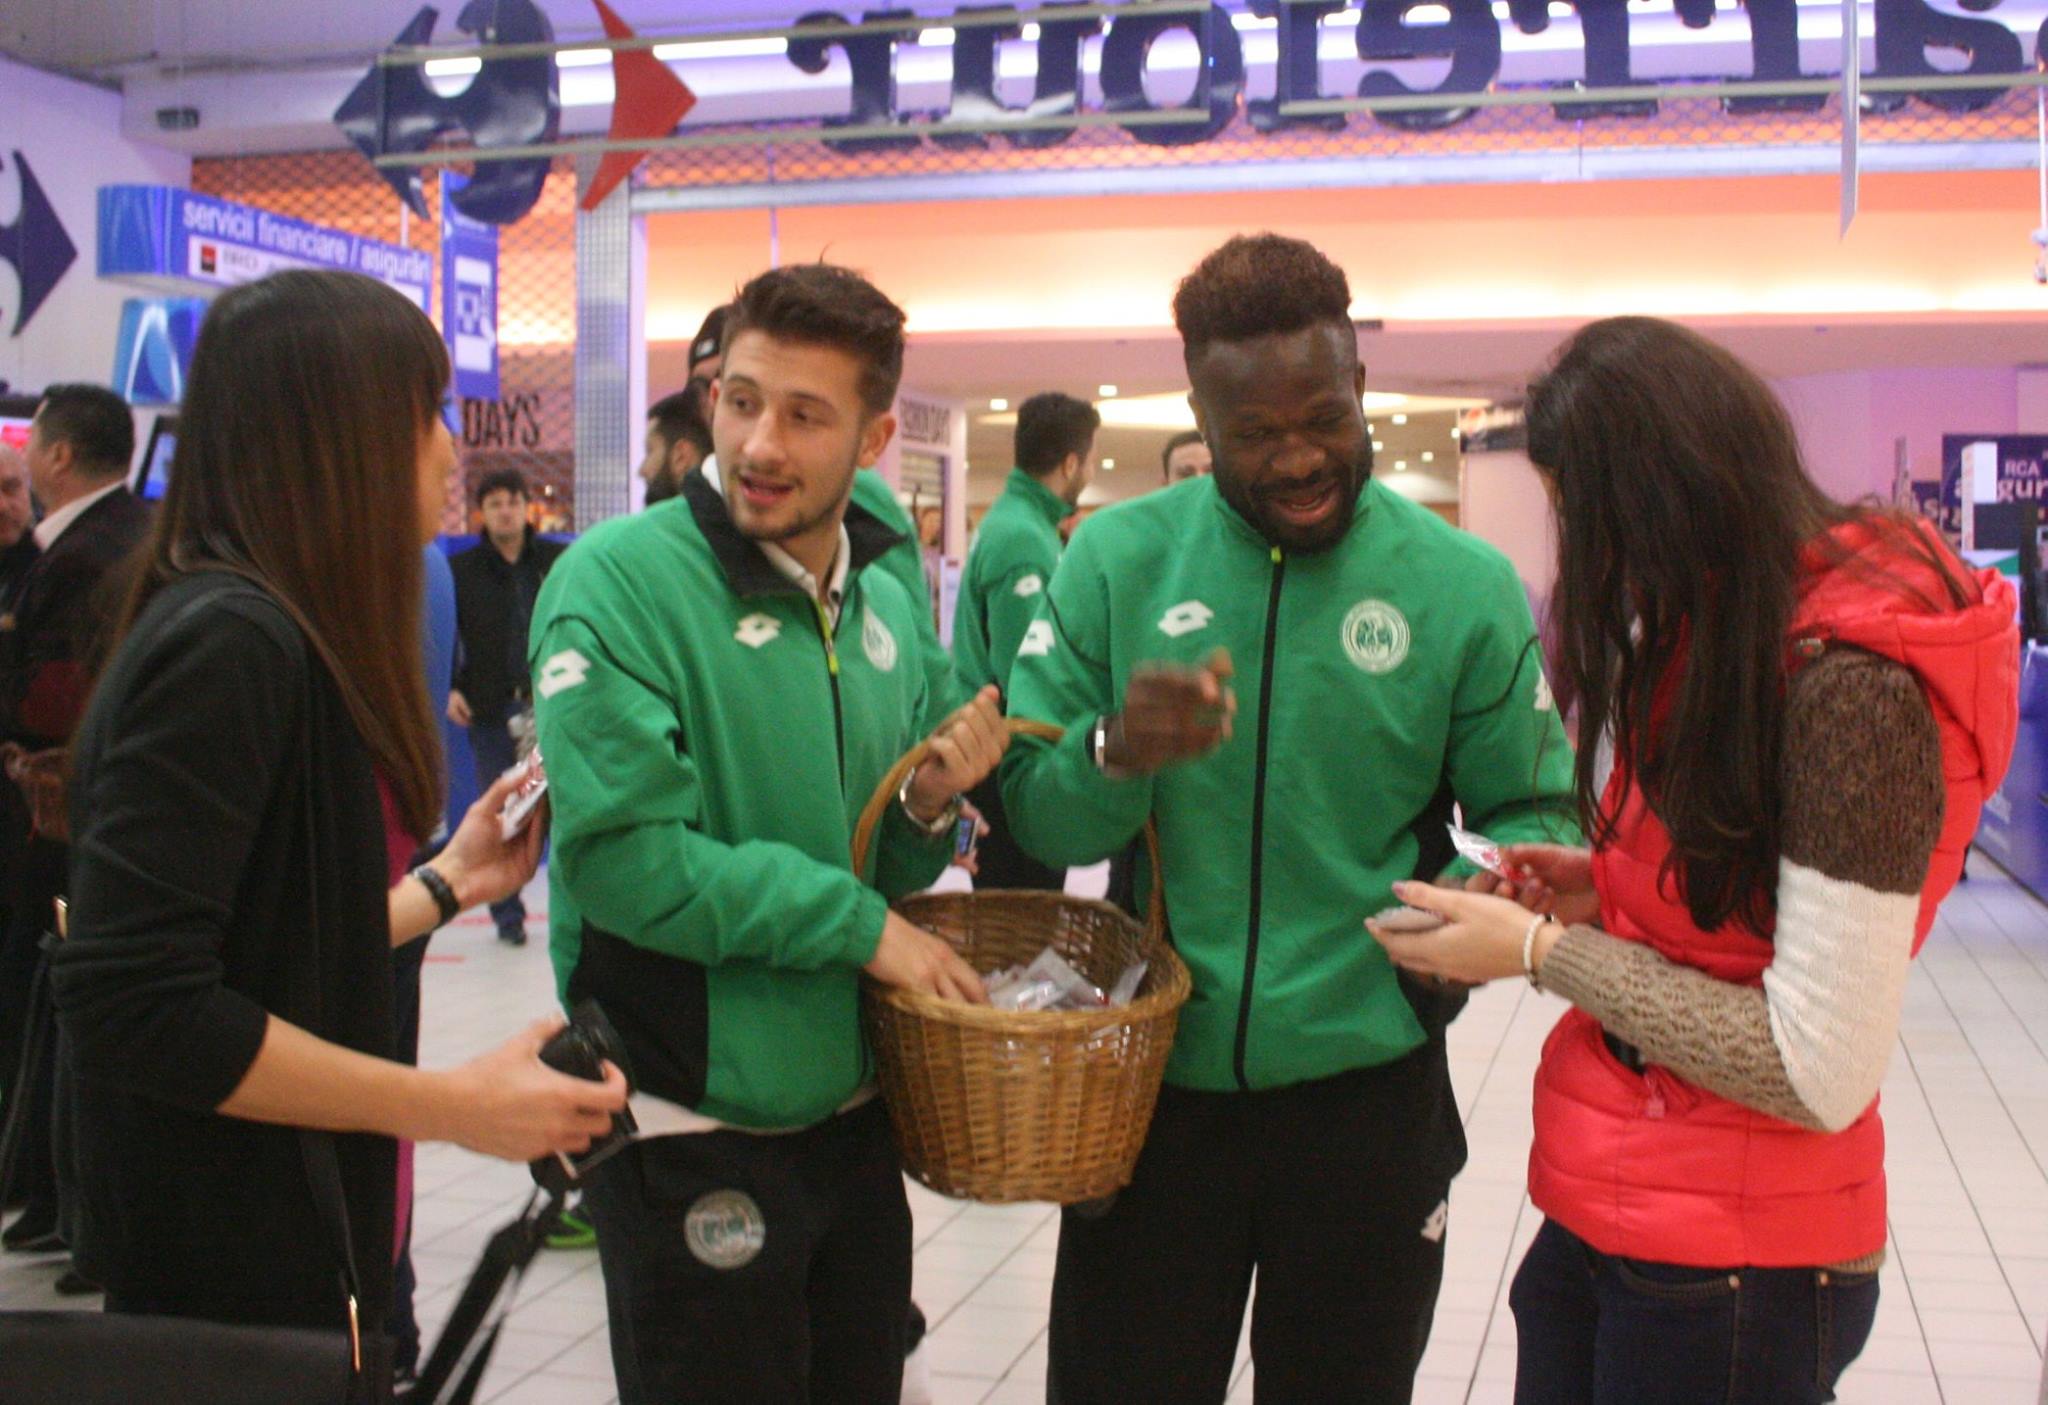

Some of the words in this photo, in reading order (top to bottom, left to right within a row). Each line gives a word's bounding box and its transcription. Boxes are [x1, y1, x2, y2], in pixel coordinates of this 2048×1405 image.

[182, 200, 254, 241] servicii
[258, 211, 348, 265] financiare
[463, 392, 540, 447] DAYS
[2005, 459, 2040, 478] RCA
